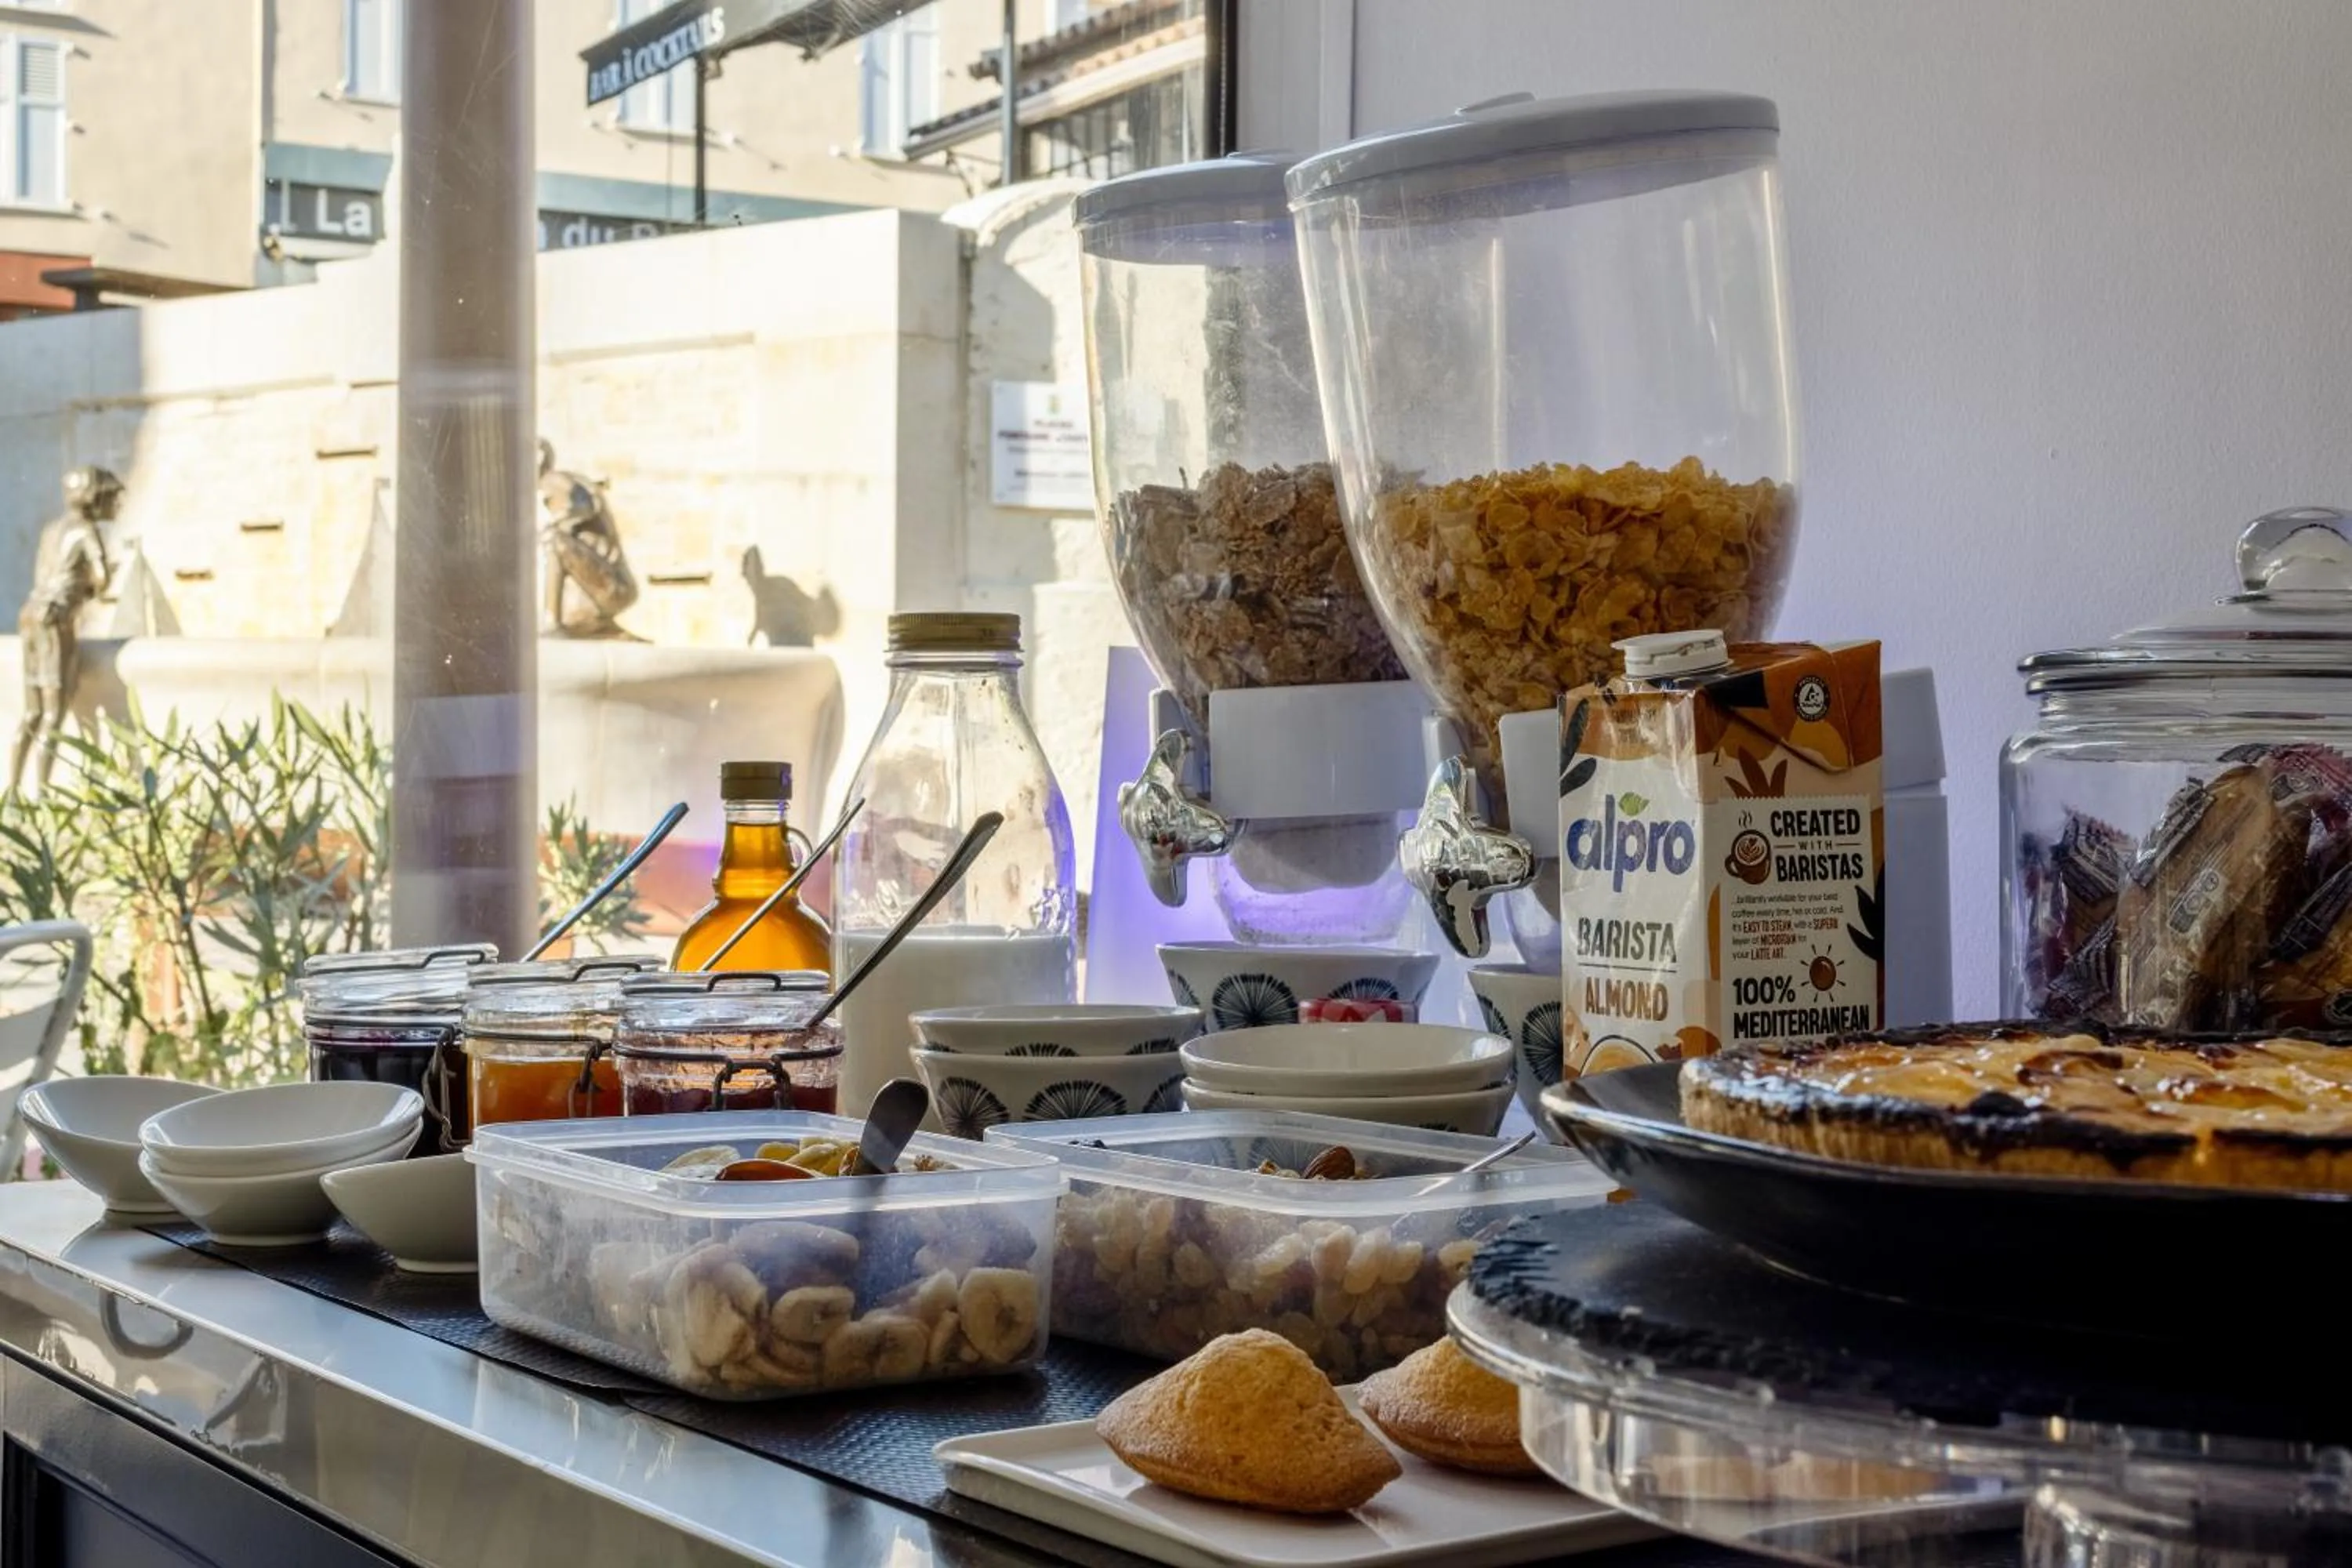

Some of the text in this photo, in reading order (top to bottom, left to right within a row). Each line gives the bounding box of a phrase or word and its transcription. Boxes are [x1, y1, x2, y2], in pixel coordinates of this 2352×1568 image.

[317, 189, 372, 236] La
[1770, 808, 1860, 837] CREATED
[1566, 794, 1695, 893] alpro
[1798, 840, 1833, 851] WITH
[1776, 853, 1864, 882] BARISTAS
[1577, 917, 1677, 964] BARISTA
[1743, 920, 1760, 934] EASY
[1761, 920, 1770, 932] TO
[1751, 948, 1770, 960] LATTE
[1585, 977, 1669, 1021] ALMOND
[1733, 975, 1796, 1005] 100%
[1733, 1004, 1870, 1039] MEDITERRANEAN
